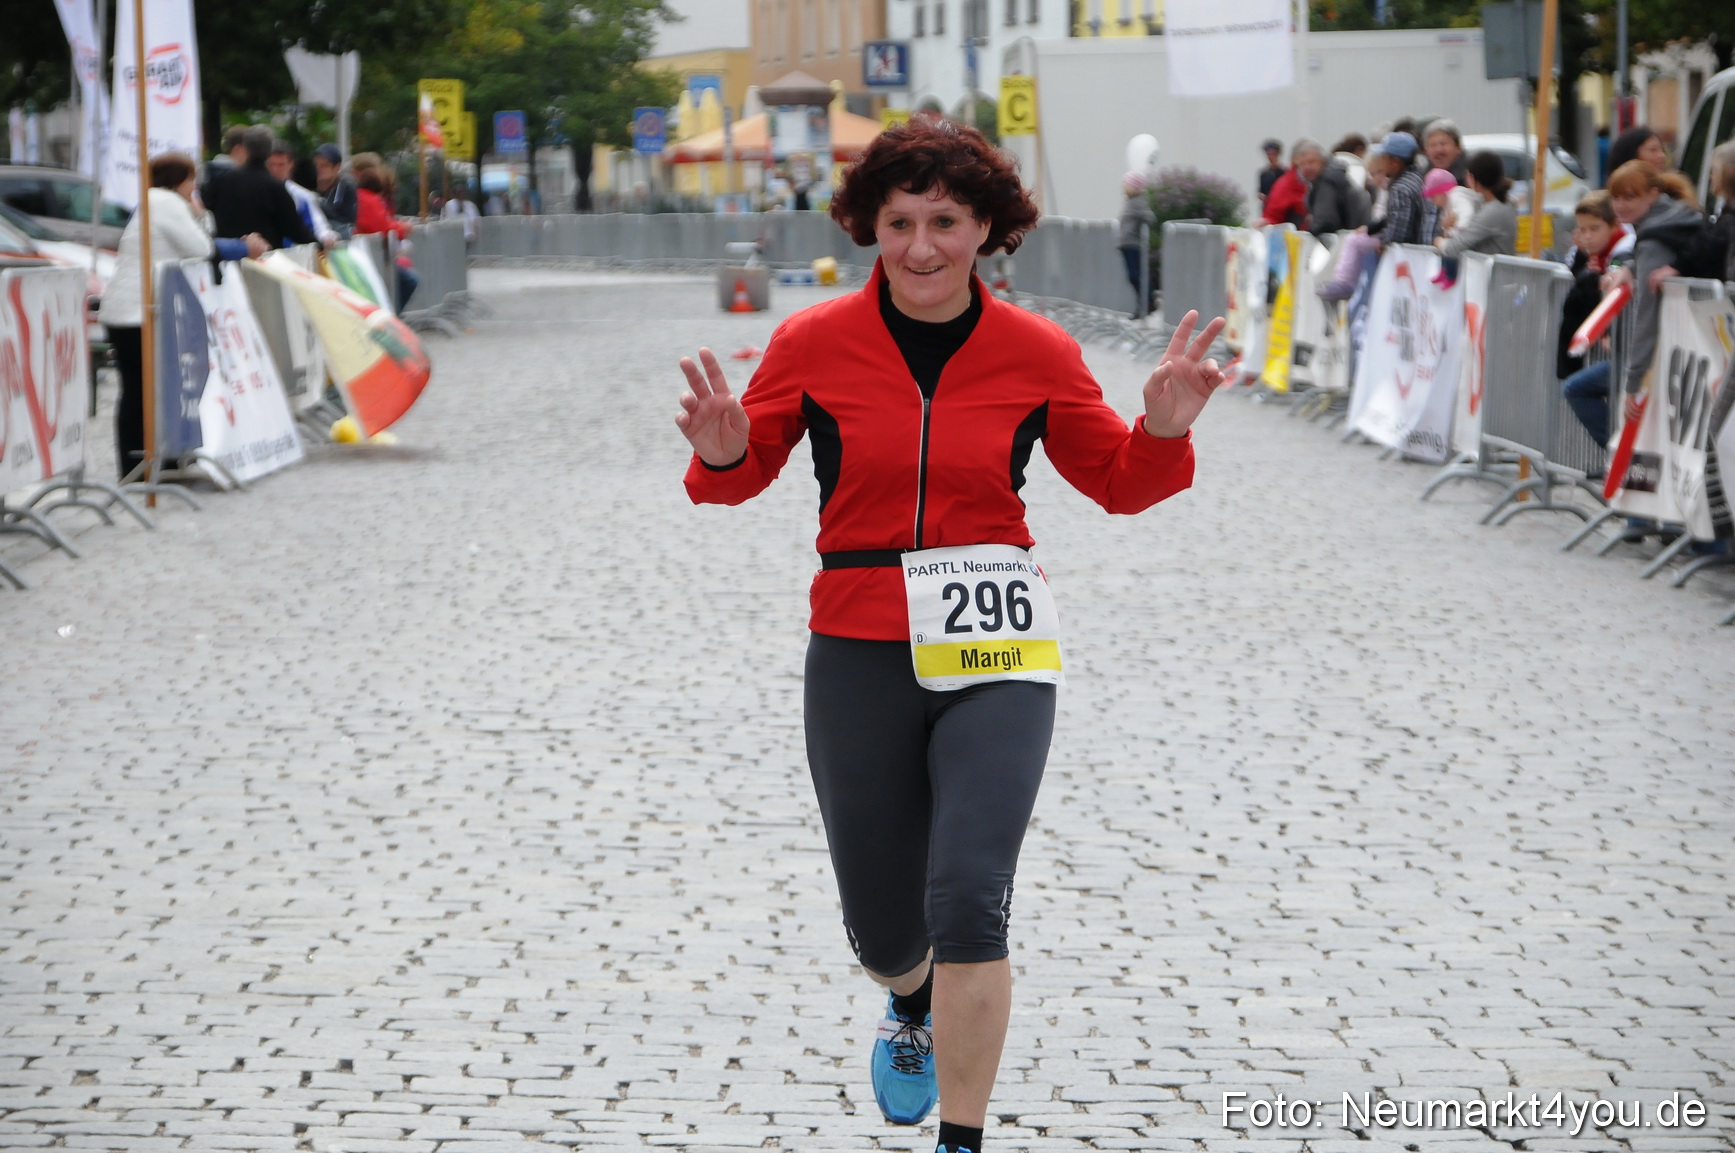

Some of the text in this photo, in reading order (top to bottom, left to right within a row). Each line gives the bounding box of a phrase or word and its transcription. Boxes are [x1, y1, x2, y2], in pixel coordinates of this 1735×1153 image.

[1007, 92, 1028, 121] C
[908, 560, 1028, 578] PARTL Neumarkt
[942, 580, 1033, 634] 296
[917, 634, 923, 643] D
[960, 647, 1024, 671] Margit
